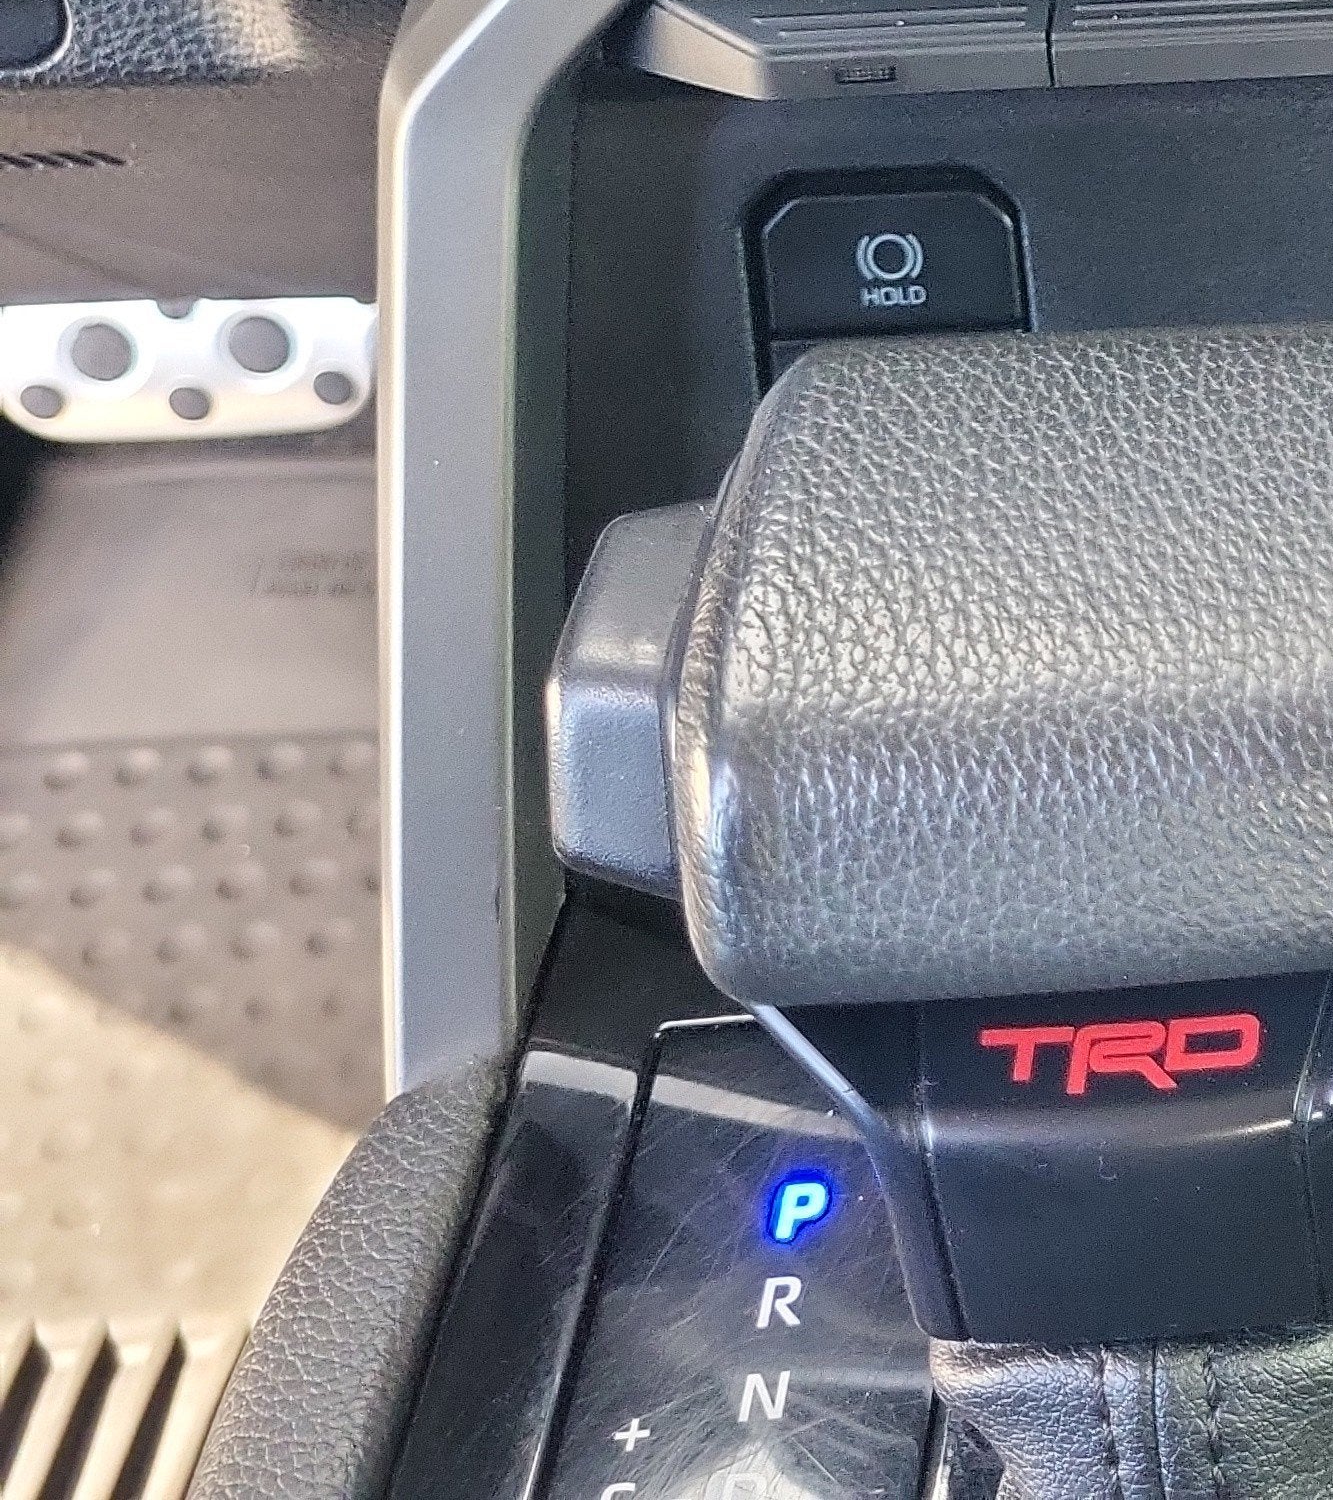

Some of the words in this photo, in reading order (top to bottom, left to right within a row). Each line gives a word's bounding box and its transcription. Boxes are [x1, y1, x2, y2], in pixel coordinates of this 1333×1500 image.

[860, 285, 928, 307] HOLD
[979, 1012, 1263, 1097] TRD
[774, 1181, 829, 1242] P
[756, 1275, 802, 1329] R
[737, 1370, 791, 1423] N
